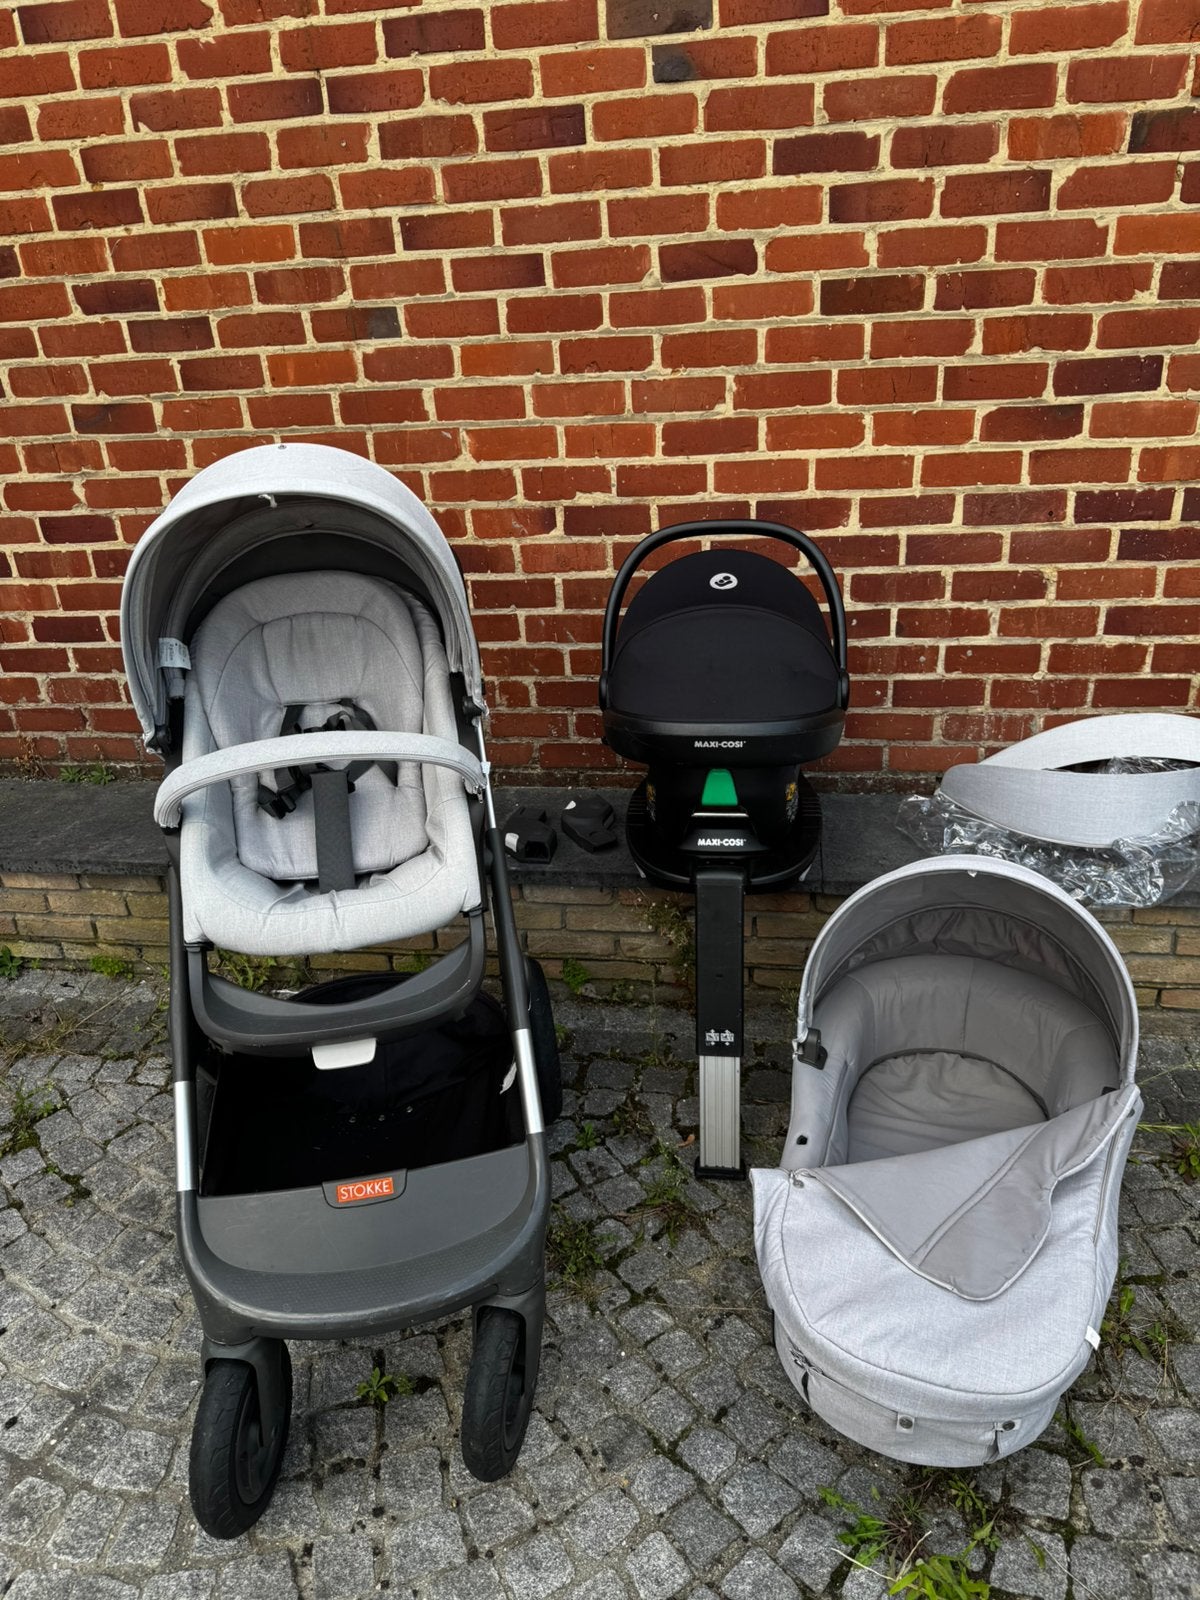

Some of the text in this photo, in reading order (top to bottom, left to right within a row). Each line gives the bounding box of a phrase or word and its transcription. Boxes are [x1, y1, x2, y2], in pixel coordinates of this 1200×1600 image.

[694, 740, 744, 748] MAXI-COSI
[697, 838, 745, 847] MAXI-COSI
[340, 1180, 391, 1199] STOKKE
